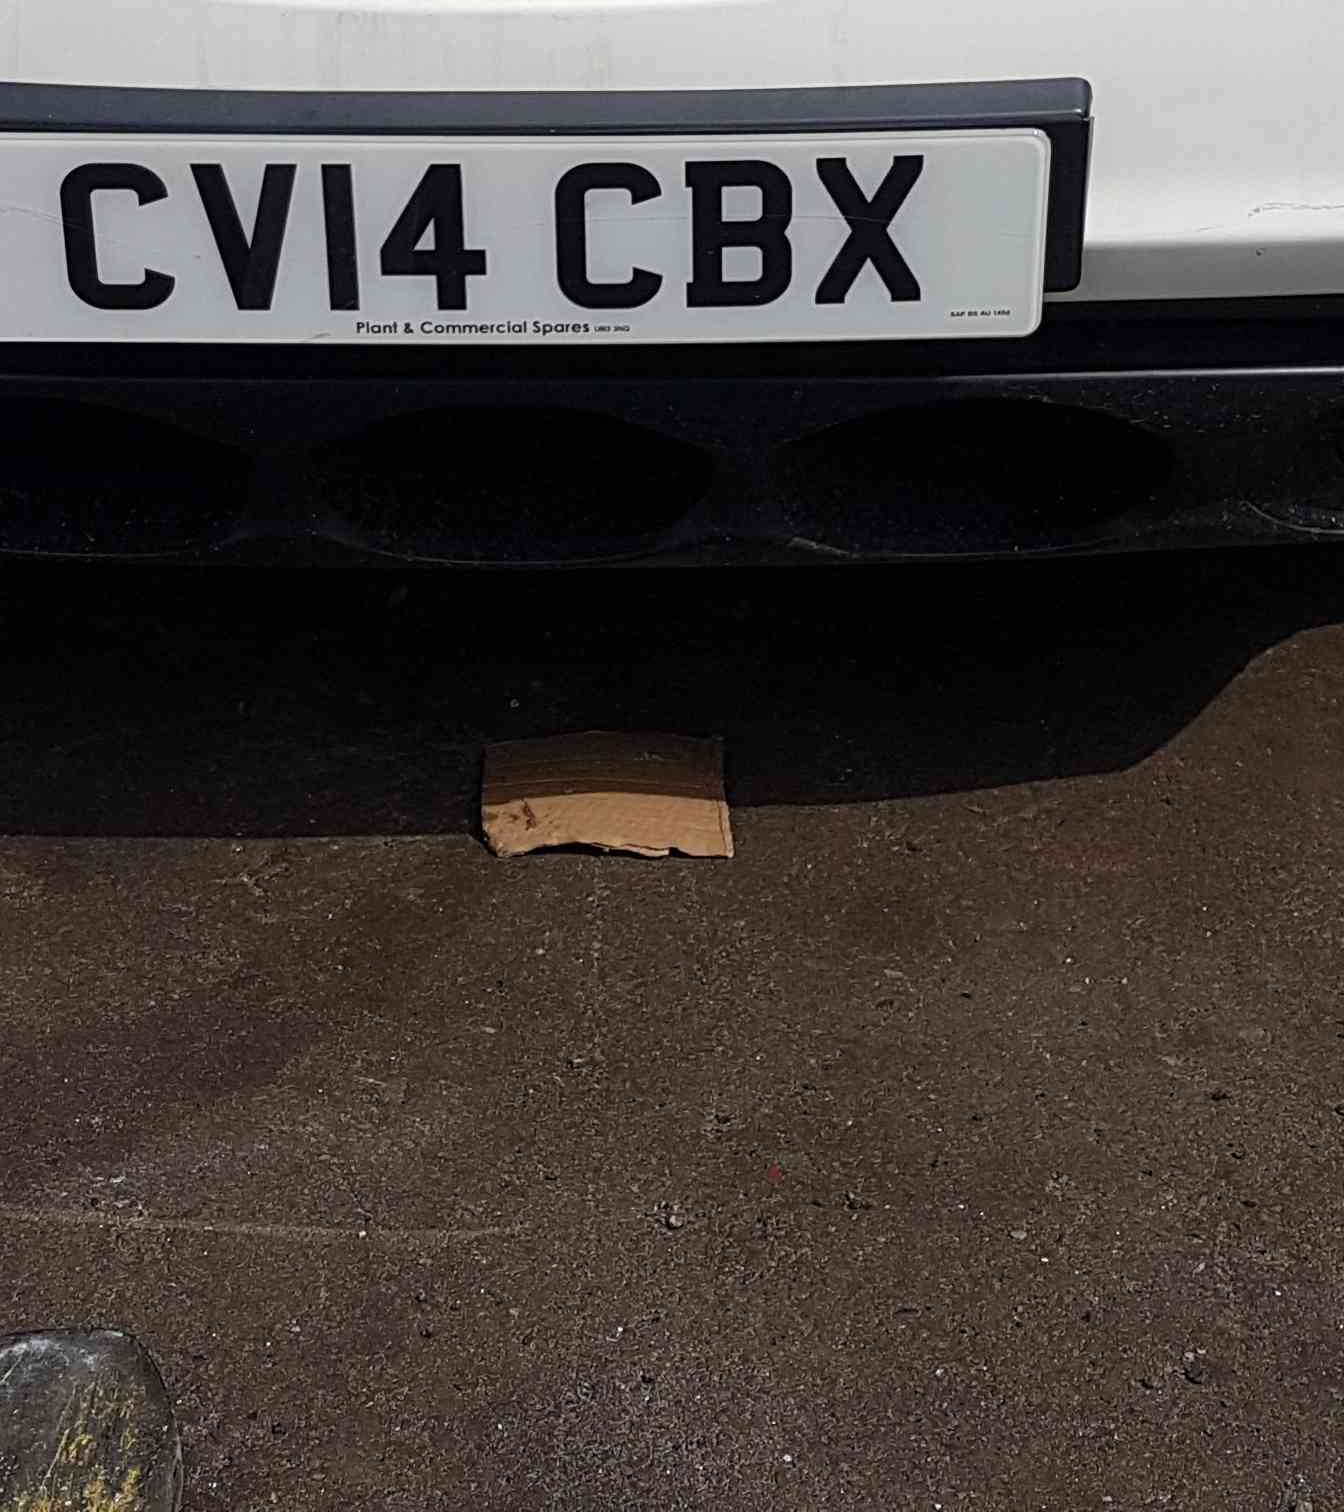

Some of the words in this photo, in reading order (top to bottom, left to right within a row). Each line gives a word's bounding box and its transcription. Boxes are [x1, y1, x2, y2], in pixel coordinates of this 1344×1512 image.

[57, 161, 487, 312] CV14
[553, 155, 925, 312] CBX
[356, 321, 398, 334] Plant
[403, 321, 414, 334] &
[420, 320, 527, 334] Commercial
[532, 320, 591, 336] Spares
